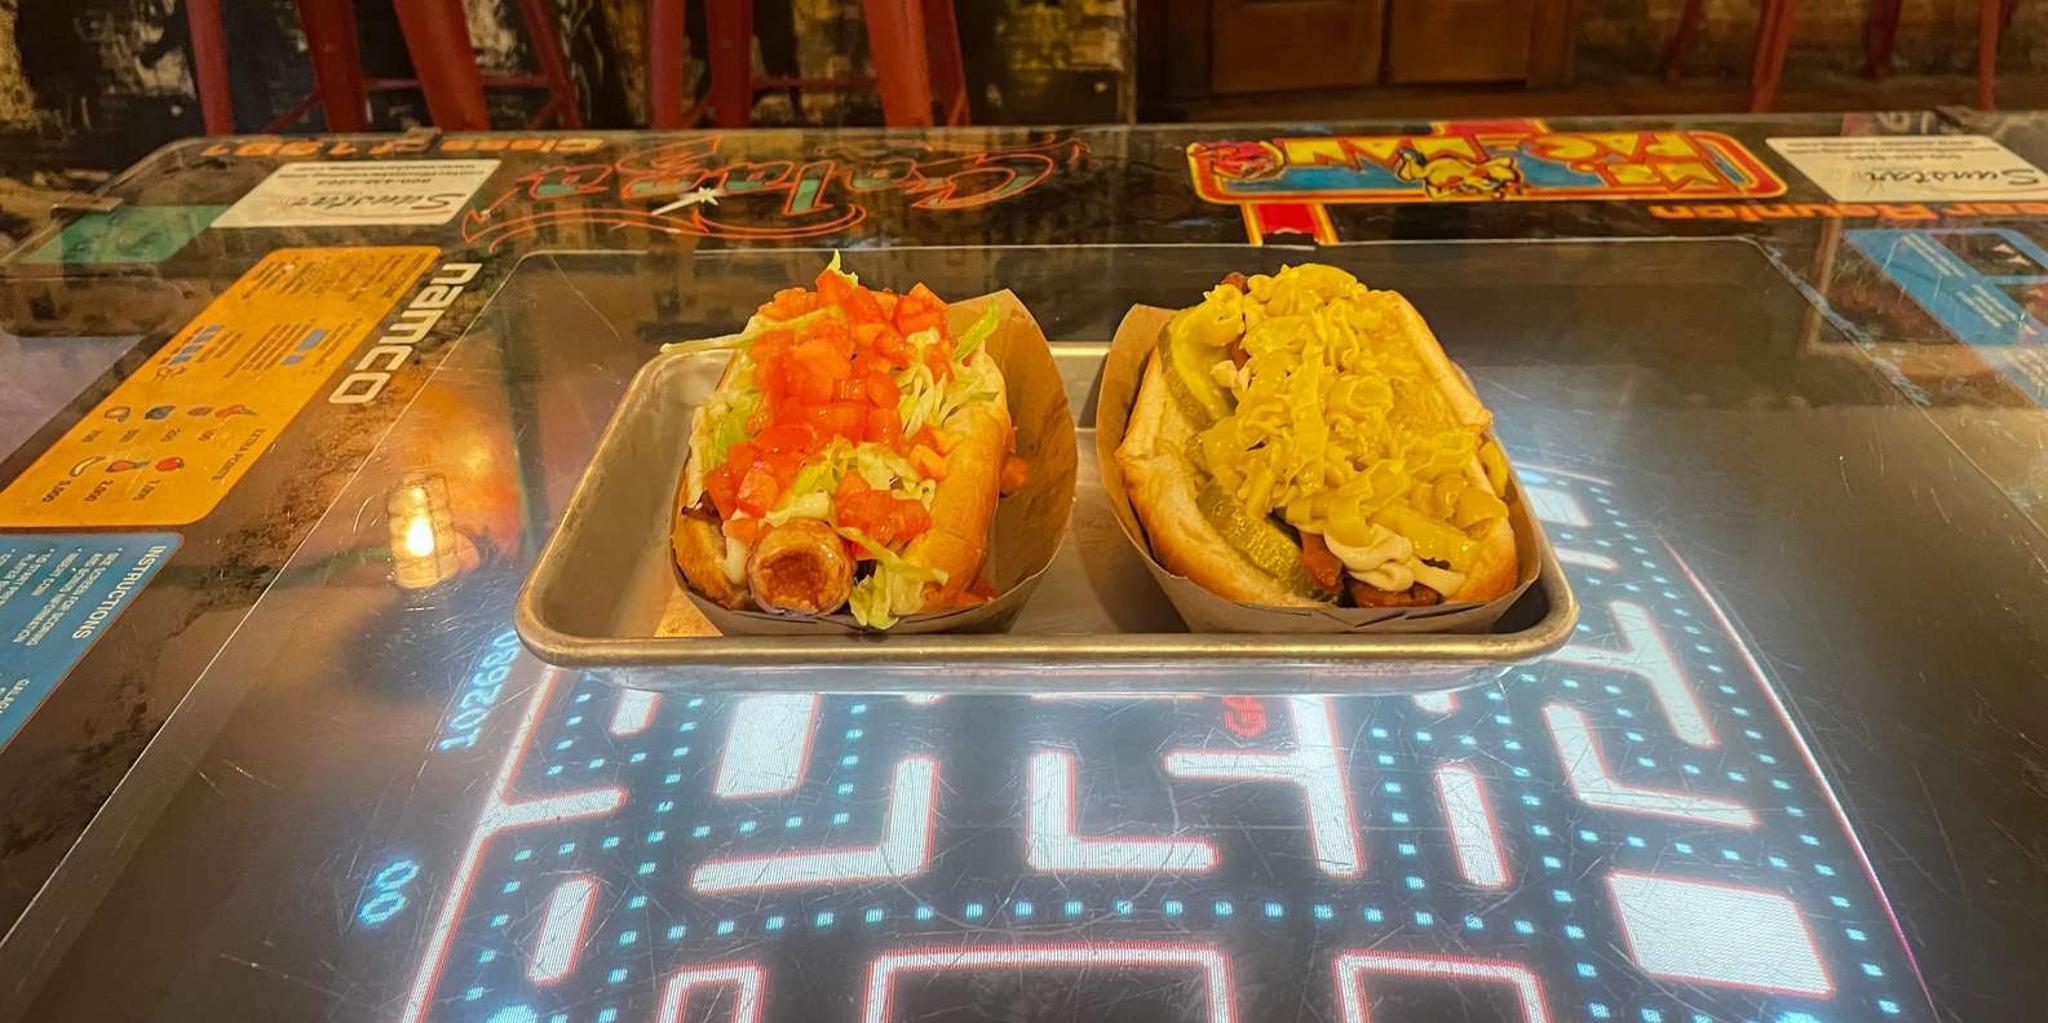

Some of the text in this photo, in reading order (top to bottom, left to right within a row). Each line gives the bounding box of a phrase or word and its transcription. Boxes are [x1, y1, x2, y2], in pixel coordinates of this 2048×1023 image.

[1866, 168, 2041, 187] Sunstar
[291, 192, 467, 211] Sunstar
[1650, 203, 1939, 222] Reunion
[328, 262, 483, 404] namco
[72, 544, 167, 640] INSTRUCTIONS
[357, 858, 419, 926] 00
